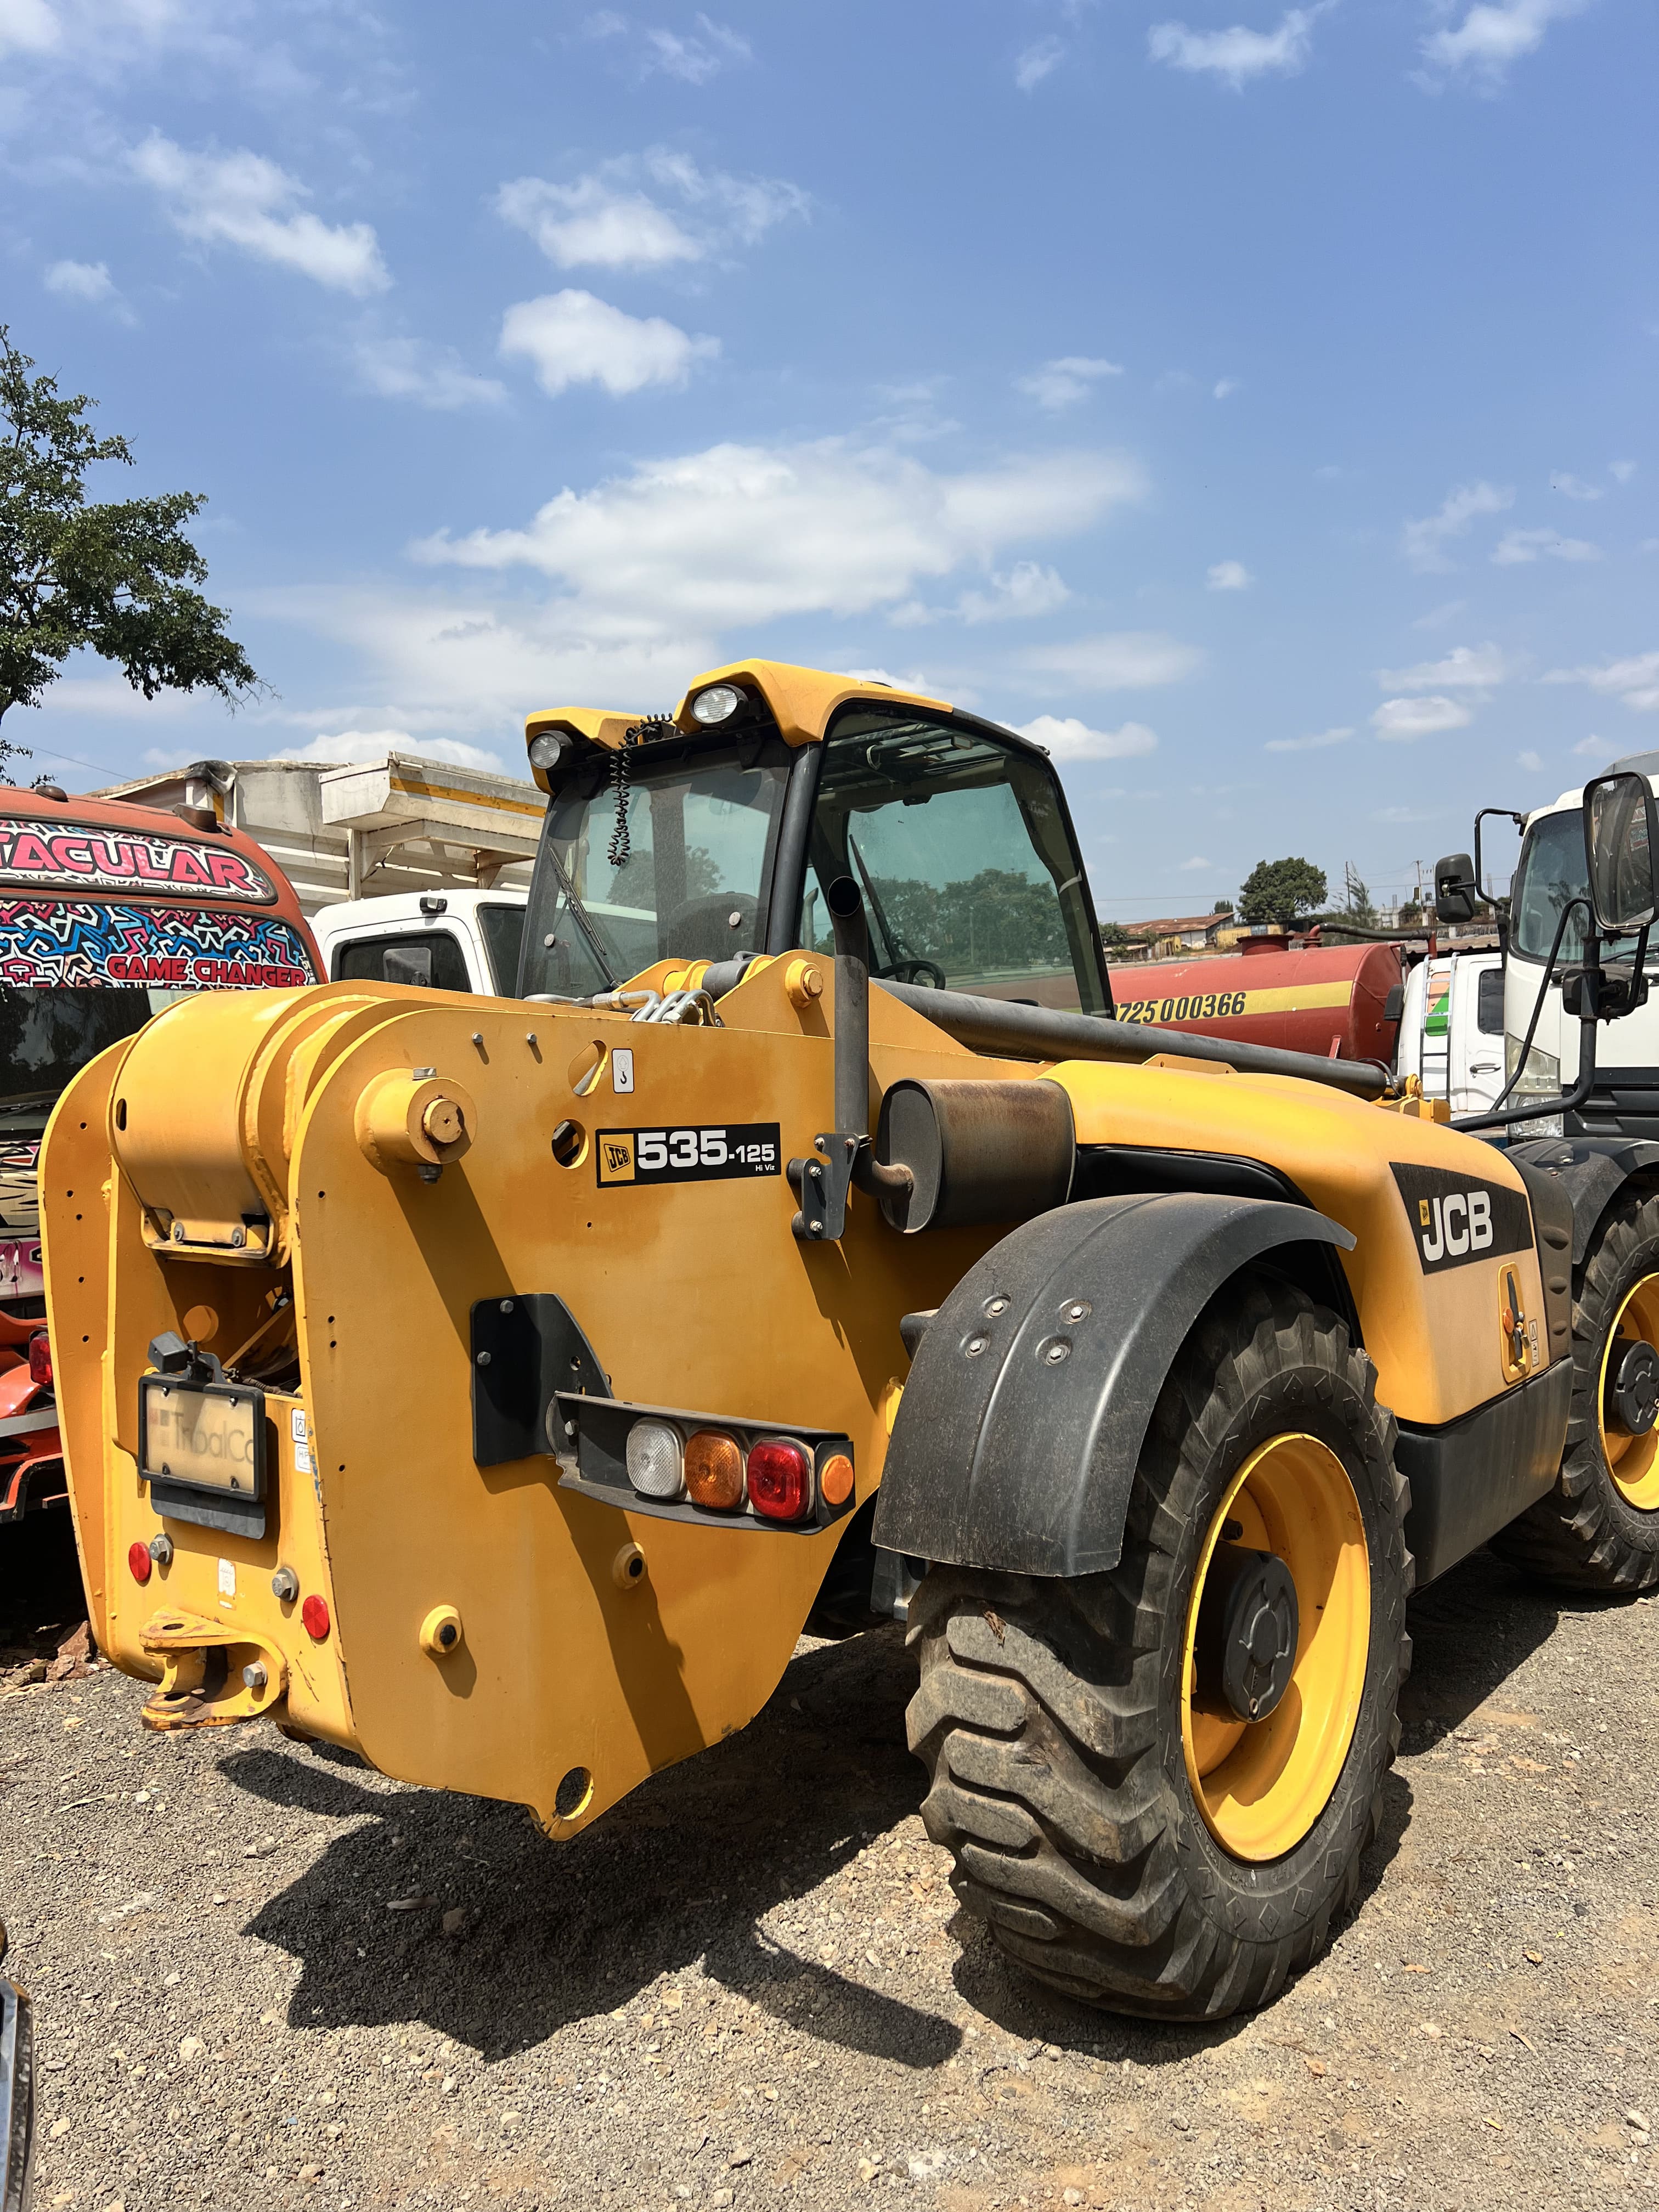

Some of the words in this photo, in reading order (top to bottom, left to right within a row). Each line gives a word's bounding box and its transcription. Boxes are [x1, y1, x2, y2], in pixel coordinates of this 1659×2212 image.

[107, 957, 188, 981] GAME
[194, 960, 306, 986] CHANGER
[1114, 1000, 1159, 1024] 725
[1160, 992, 1246, 1022] 000366
[608, 1146, 629, 1169] JCB
[637, 1130, 775, 1170] 535-125
[1422, 1191, 1493, 1261] JCB
